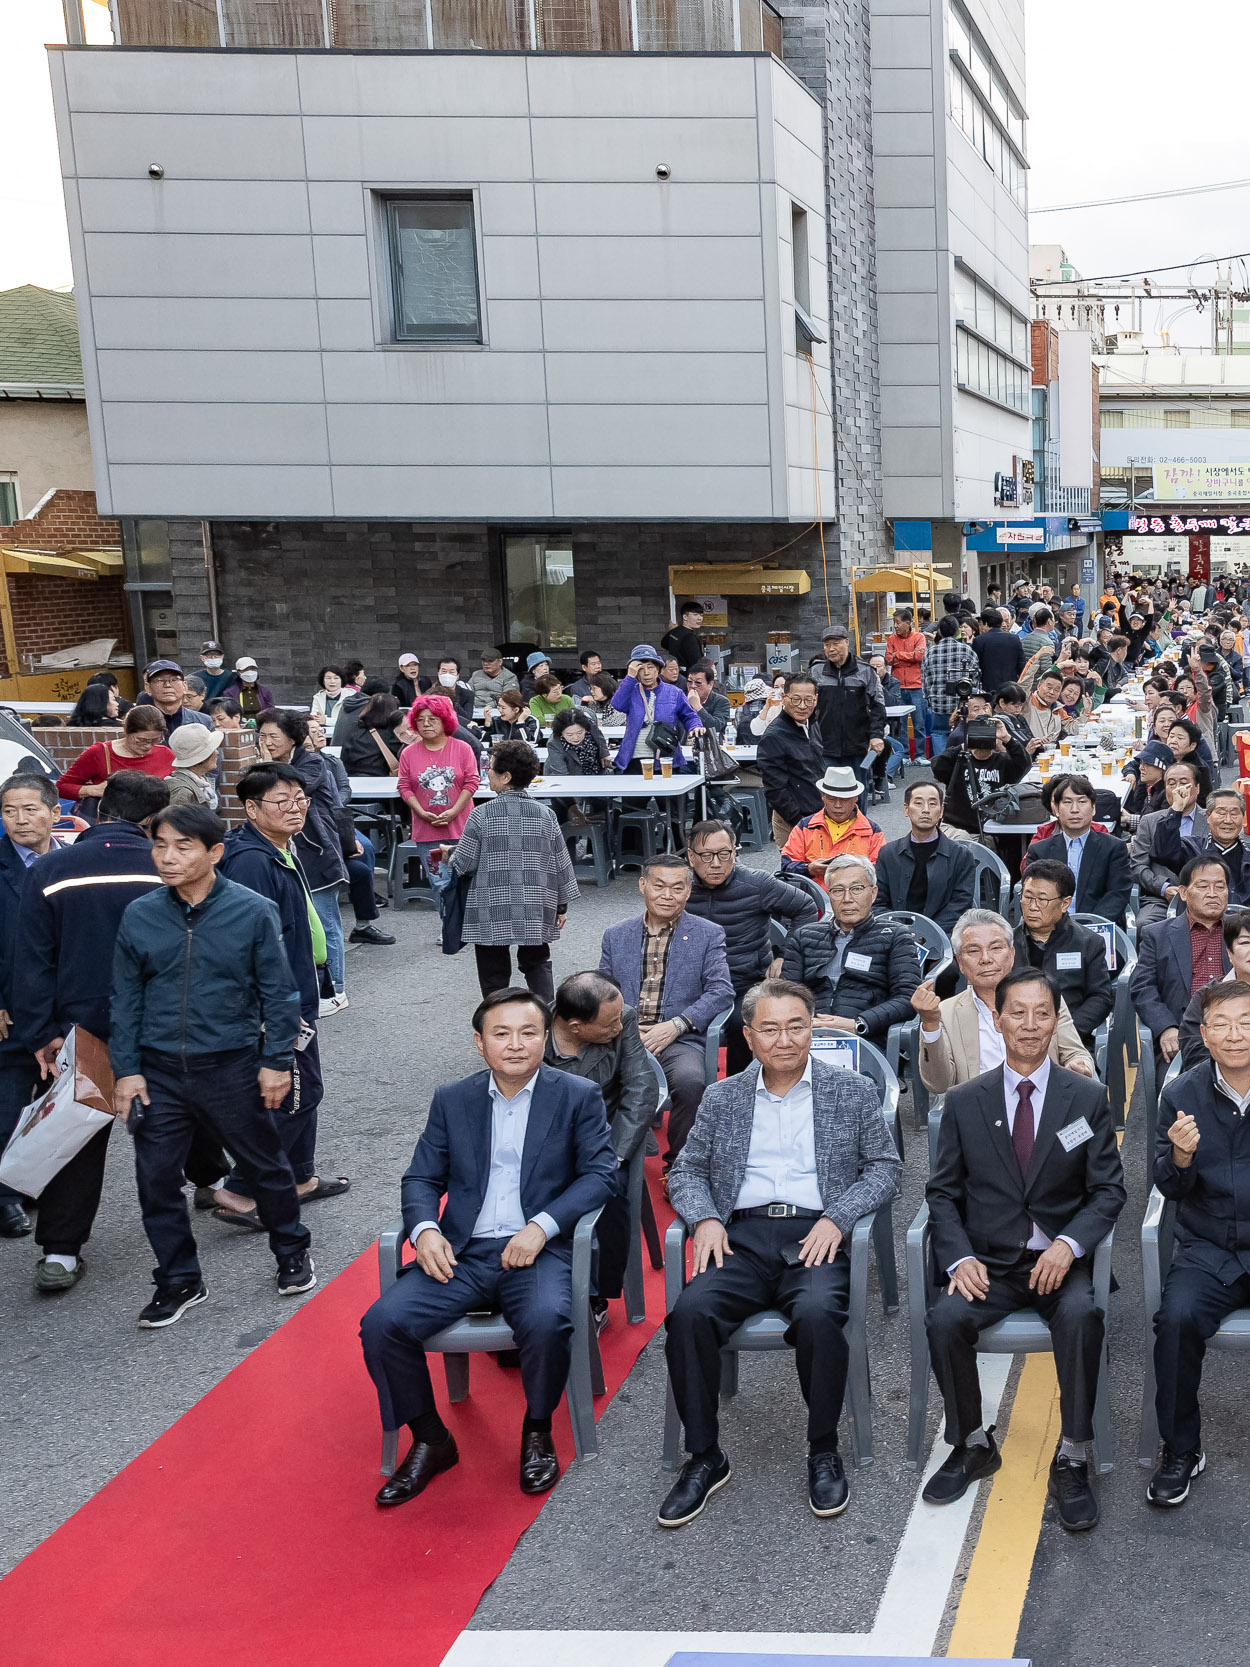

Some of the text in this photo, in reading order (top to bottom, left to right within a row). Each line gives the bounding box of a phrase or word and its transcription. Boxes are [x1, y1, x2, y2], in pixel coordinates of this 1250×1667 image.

[1159, 456, 1207, 464] 02-466-5003
[1163, 466, 1202, 484] 잠깐!
[1205, 467, 1244, 477] 시장에서도
[1205, 478, 1244, 488] 장바구니를
[1136, 517, 1165, 533] 명동
[1169, 514, 1218, 533] 홍두깨
